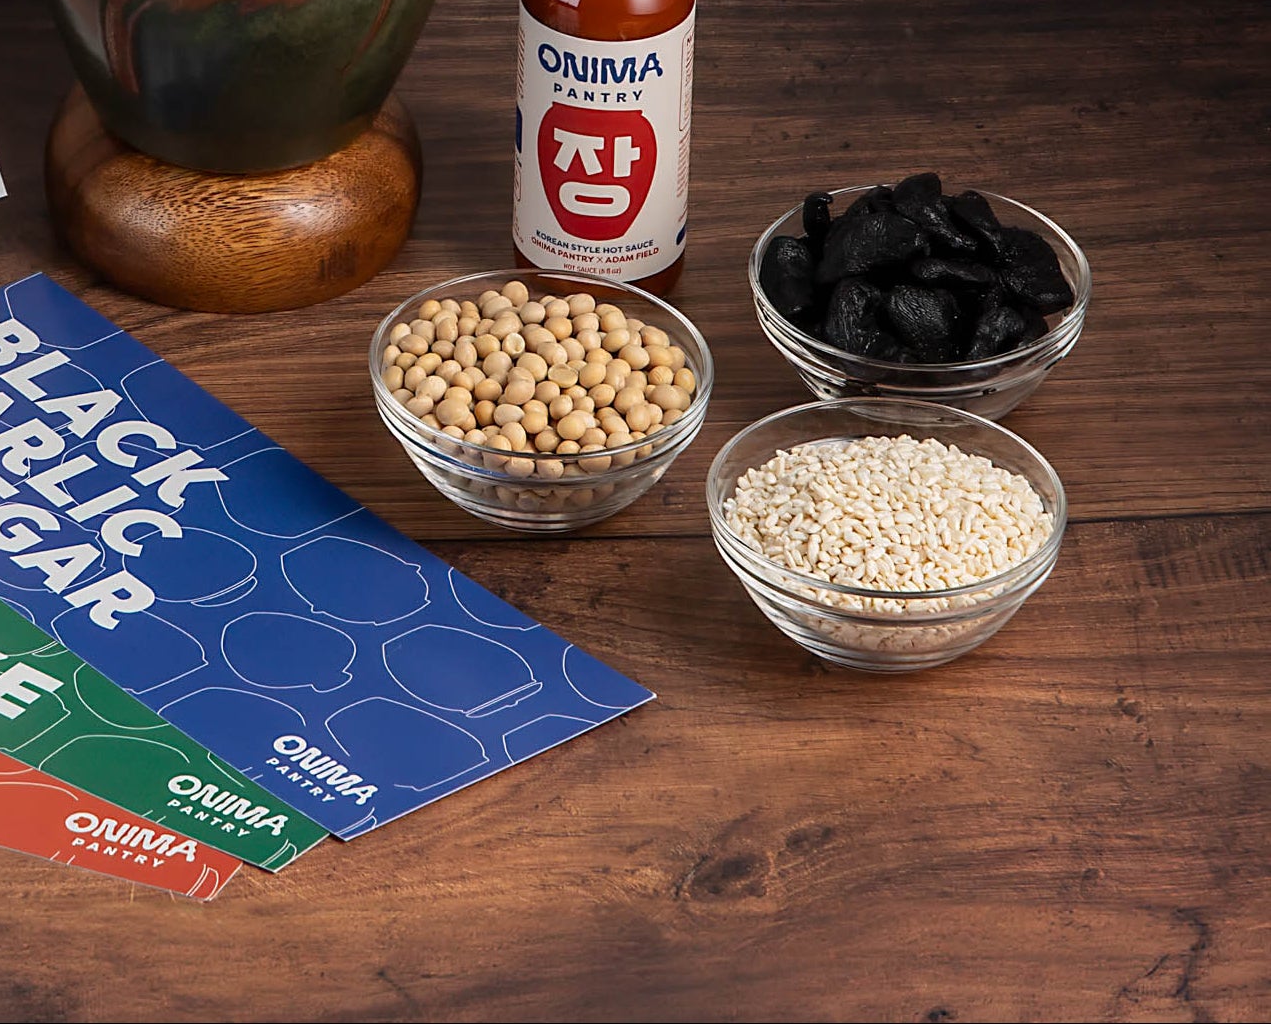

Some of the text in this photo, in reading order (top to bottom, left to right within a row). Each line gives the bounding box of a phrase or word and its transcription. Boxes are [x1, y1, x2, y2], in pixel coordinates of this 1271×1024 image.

[538, 43, 663, 84] ONIMA
[554, 83, 642, 103] PANTRY
[554, 127, 641, 218] 장
[531, 237, 556, 255] ONIMA
[558, 250, 594, 263] PANTRY
[605, 255, 634, 263] ADAM
[635, 247, 660, 260] FIELD
[536, 230, 654, 254] KOREAN STYLE HOT SAUCE
[563, 263, 575, 271] HOT
[577, 266, 597, 274] SAUCE
[266, 757, 335, 802] PANTRY
[273, 735, 378, 805] ONIMA
[167, 799, 250, 837] PANTRY
[168, 775, 288, 836] ONIMA
[65, 812, 198, 862] ONIMA
[72, 837, 165, 868] PANTRY
